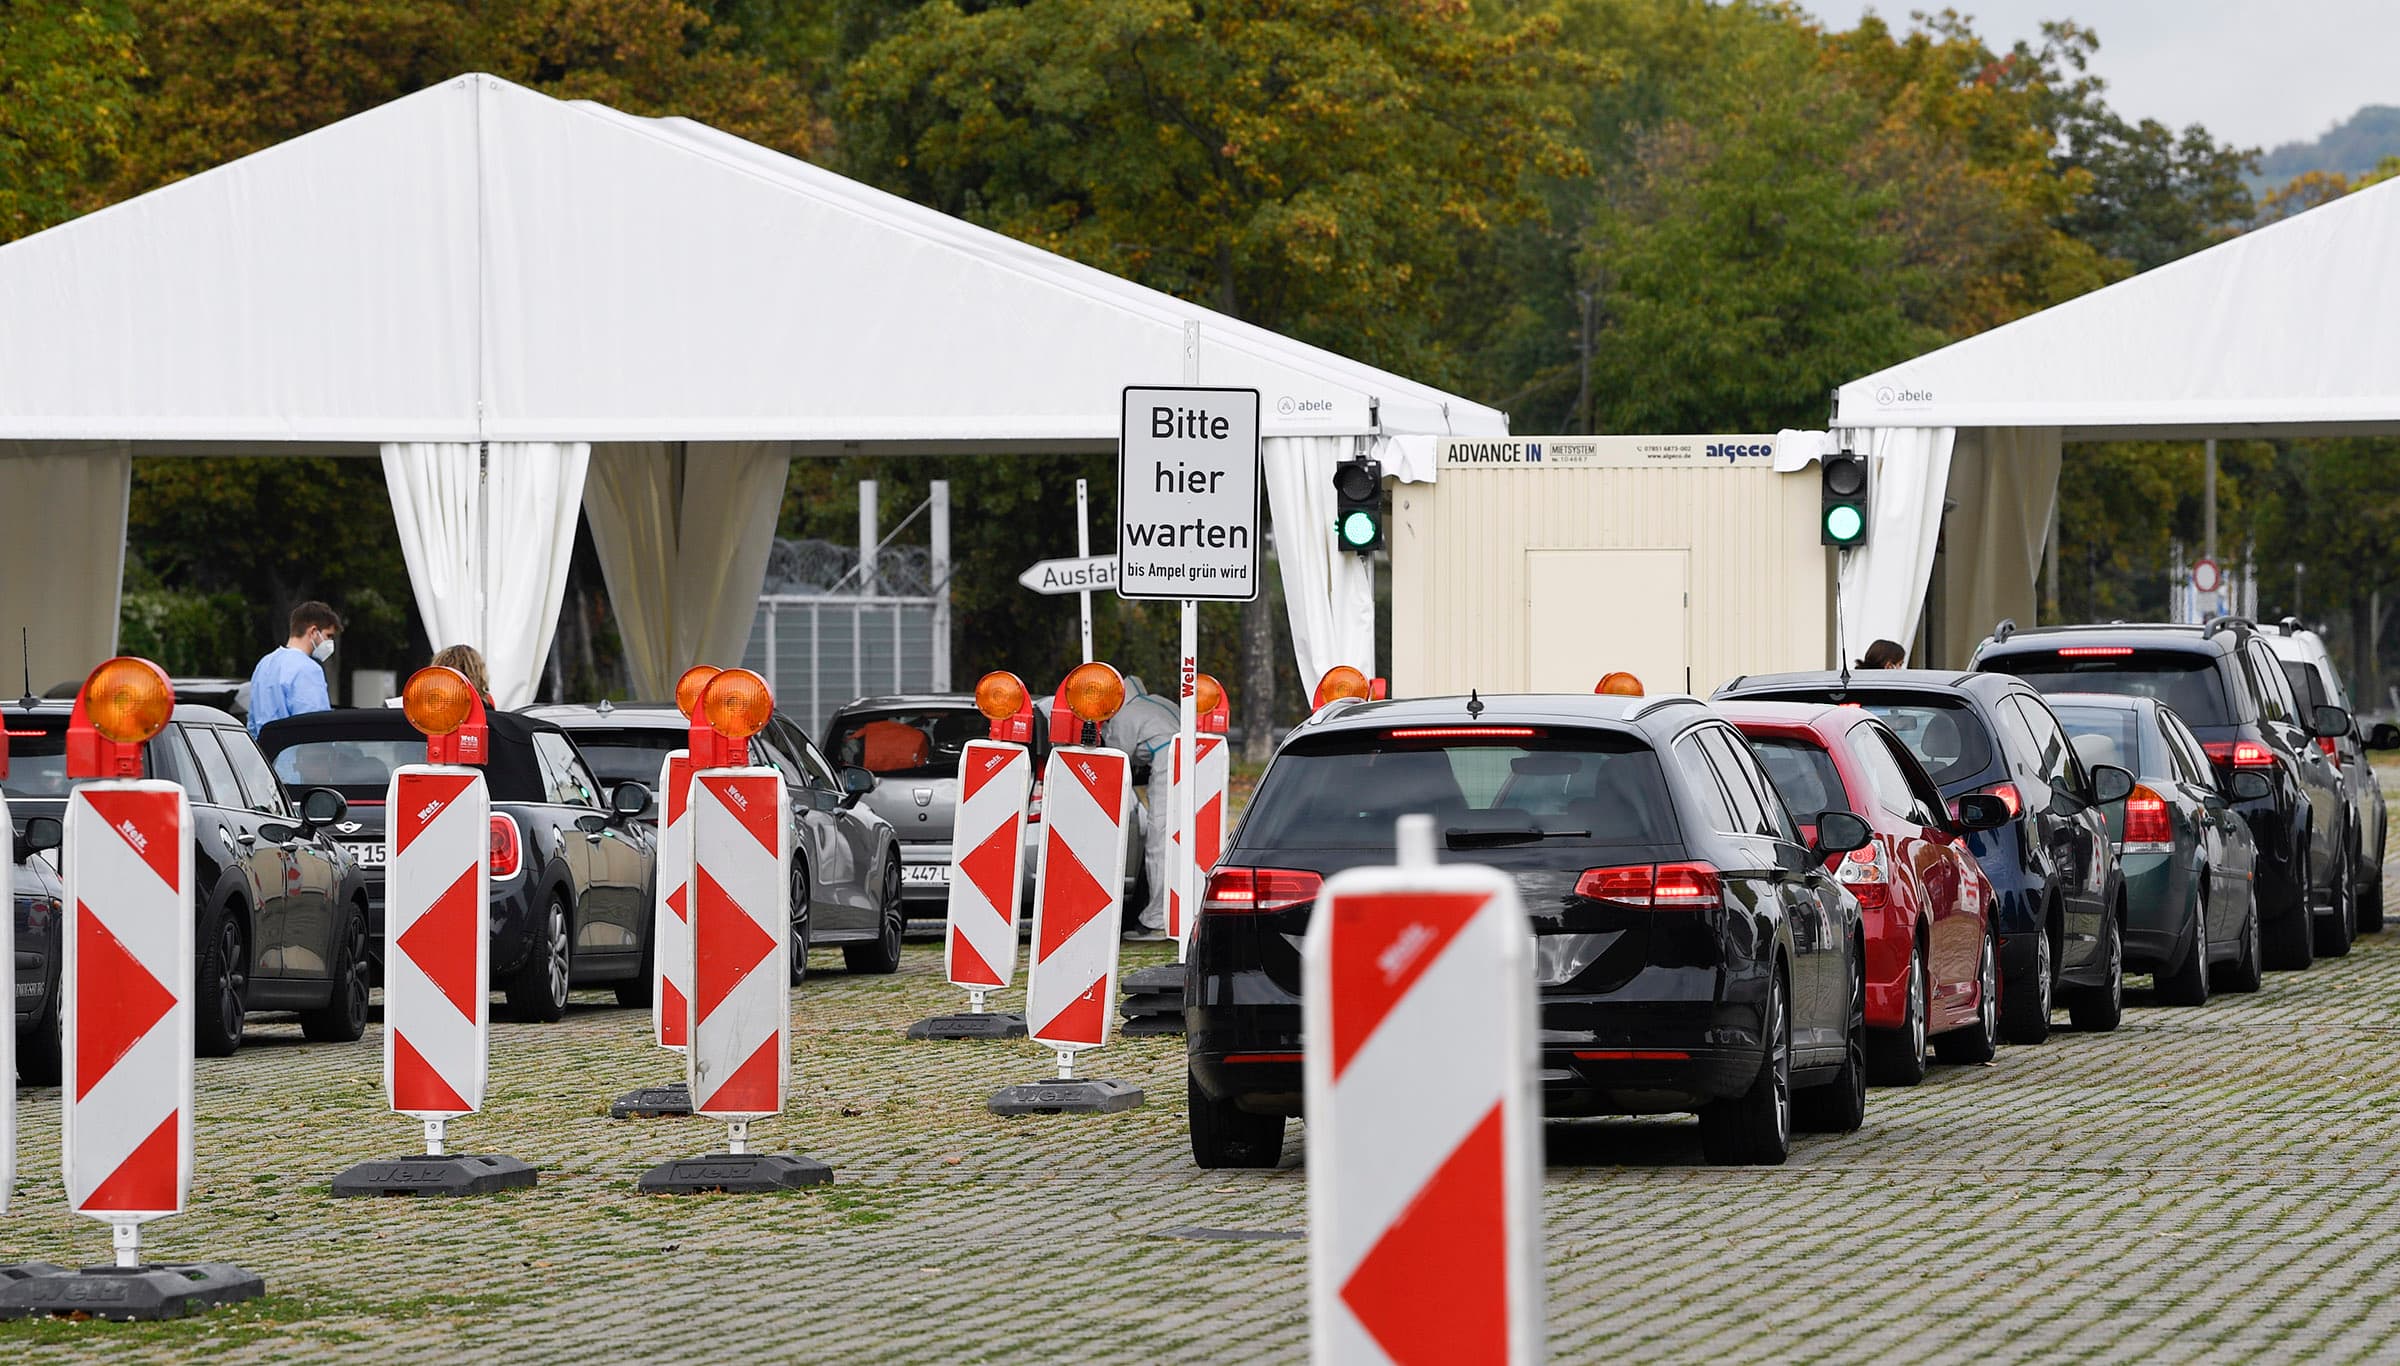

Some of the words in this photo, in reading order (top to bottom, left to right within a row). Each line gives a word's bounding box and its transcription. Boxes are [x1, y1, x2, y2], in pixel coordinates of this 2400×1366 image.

[1298, 399, 1333, 411] abele
[1897, 389, 1933, 401] abele
[1151, 406, 1229, 439] Bitte
[1448, 443, 1521, 463] ADVANCE
[1525, 443, 1542, 463] IN
[1552, 445, 1595, 455] MIETSYSTEM
[1705, 443, 1772, 464] algeco
[1155, 461, 1225, 493] hier
[1126, 518, 1248, 549] warten
[1127, 562, 1145, 577] bis
[1148, 563, 1186, 581] Ampel
[1189, 563, 1217, 581] grün
[1220, 564, 1247, 579] wird
[1182, 656, 1195, 698] Welz
[985, 754, 1002, 769] Welz
[1080, 761, 1098, 781] Welz
[727, 784, 749, 808] Welz
[417, 799, 441, 820] Welz
[122, 819, 149, 848] Welz
[364, 845, 386, 862] 15
[911, 866, 937, 881] 447
